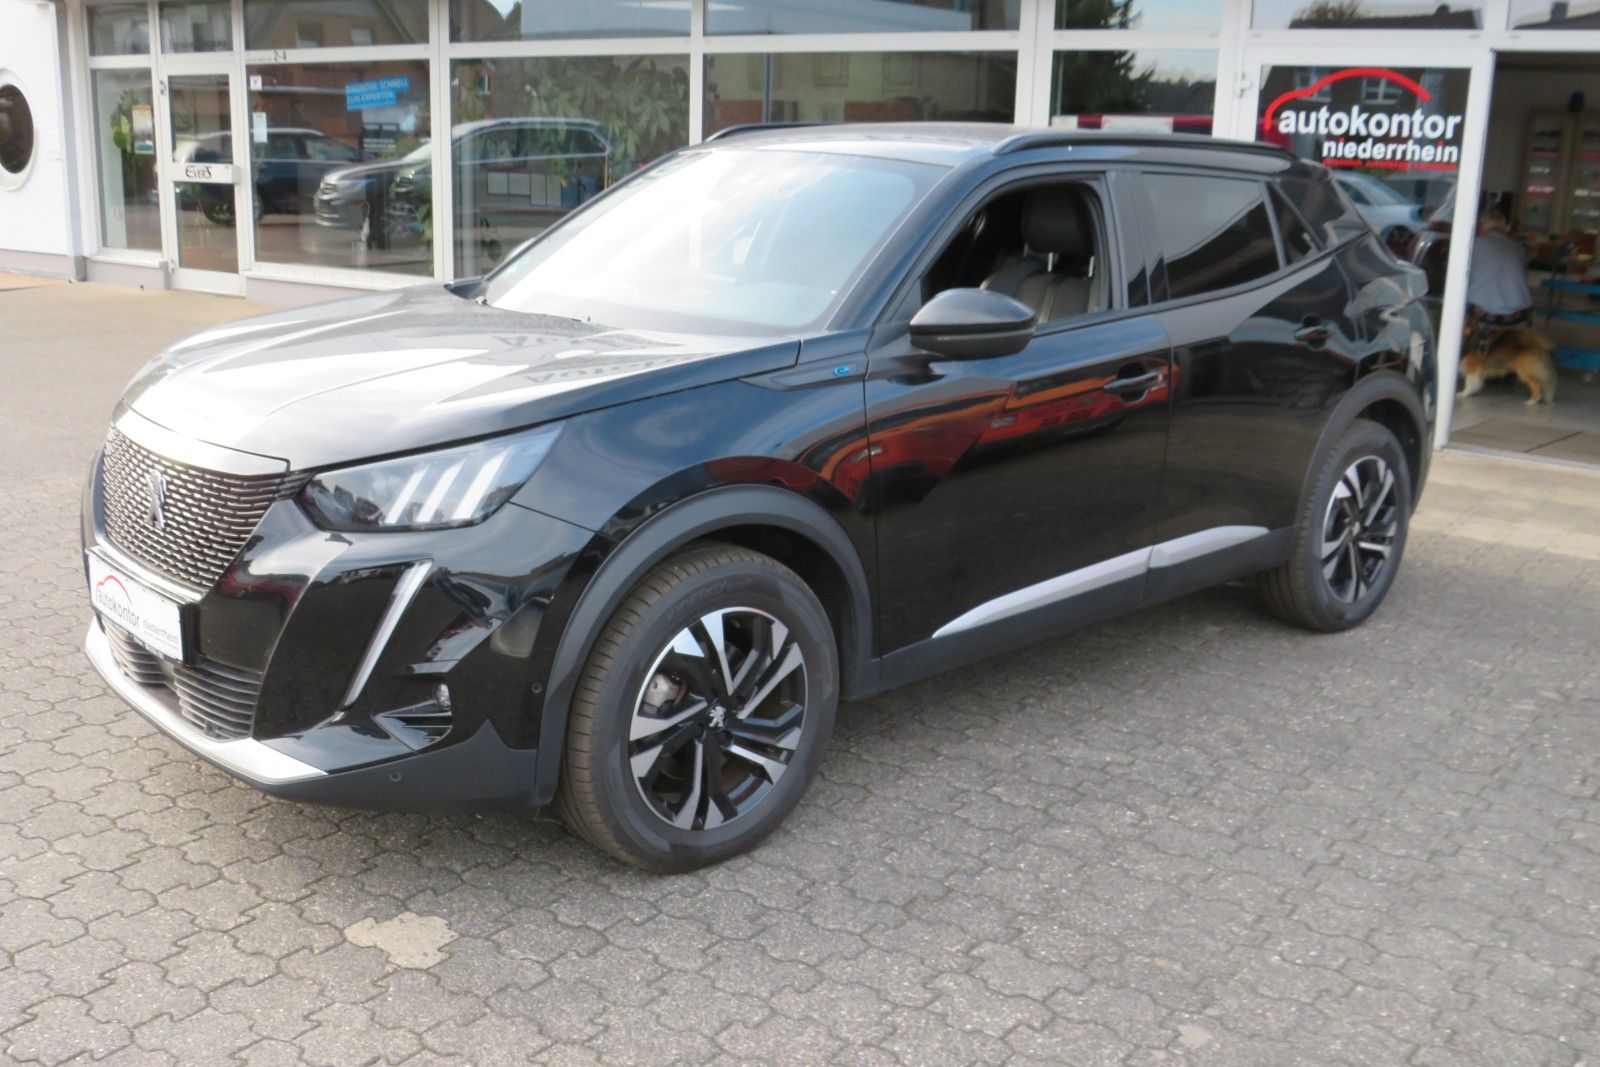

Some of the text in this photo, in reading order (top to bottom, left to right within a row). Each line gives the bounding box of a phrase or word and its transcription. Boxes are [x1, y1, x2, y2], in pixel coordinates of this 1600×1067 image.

[1278, 105, 1461, 139] autokontor
[1322, 138, 1458, 163] niederrhein
[97, 588, 140, 629] autokontor
